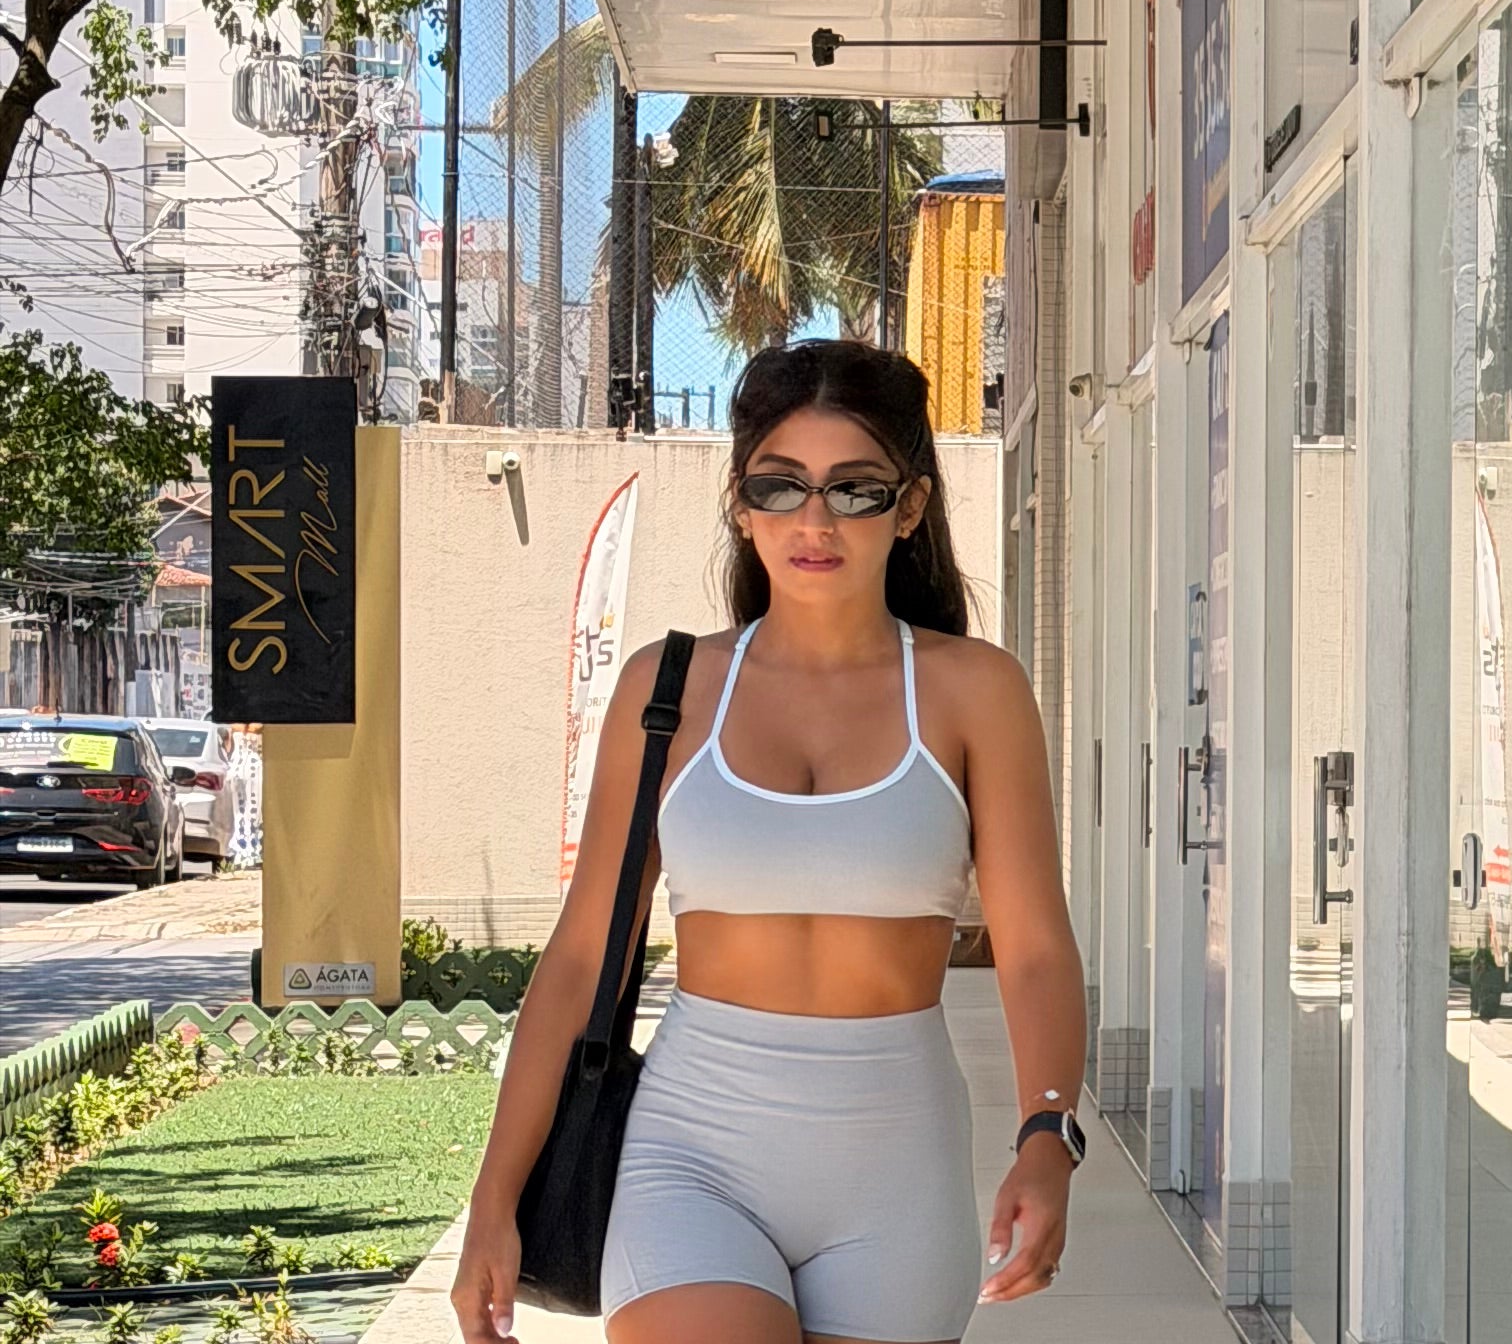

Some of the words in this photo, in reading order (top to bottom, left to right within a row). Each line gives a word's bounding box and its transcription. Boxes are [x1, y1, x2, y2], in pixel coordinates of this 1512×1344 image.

[228, 425, 287, 674] SMART
[295, 455, 339, 645] Mall
[315, 964, 369, 983] ÁGATA
